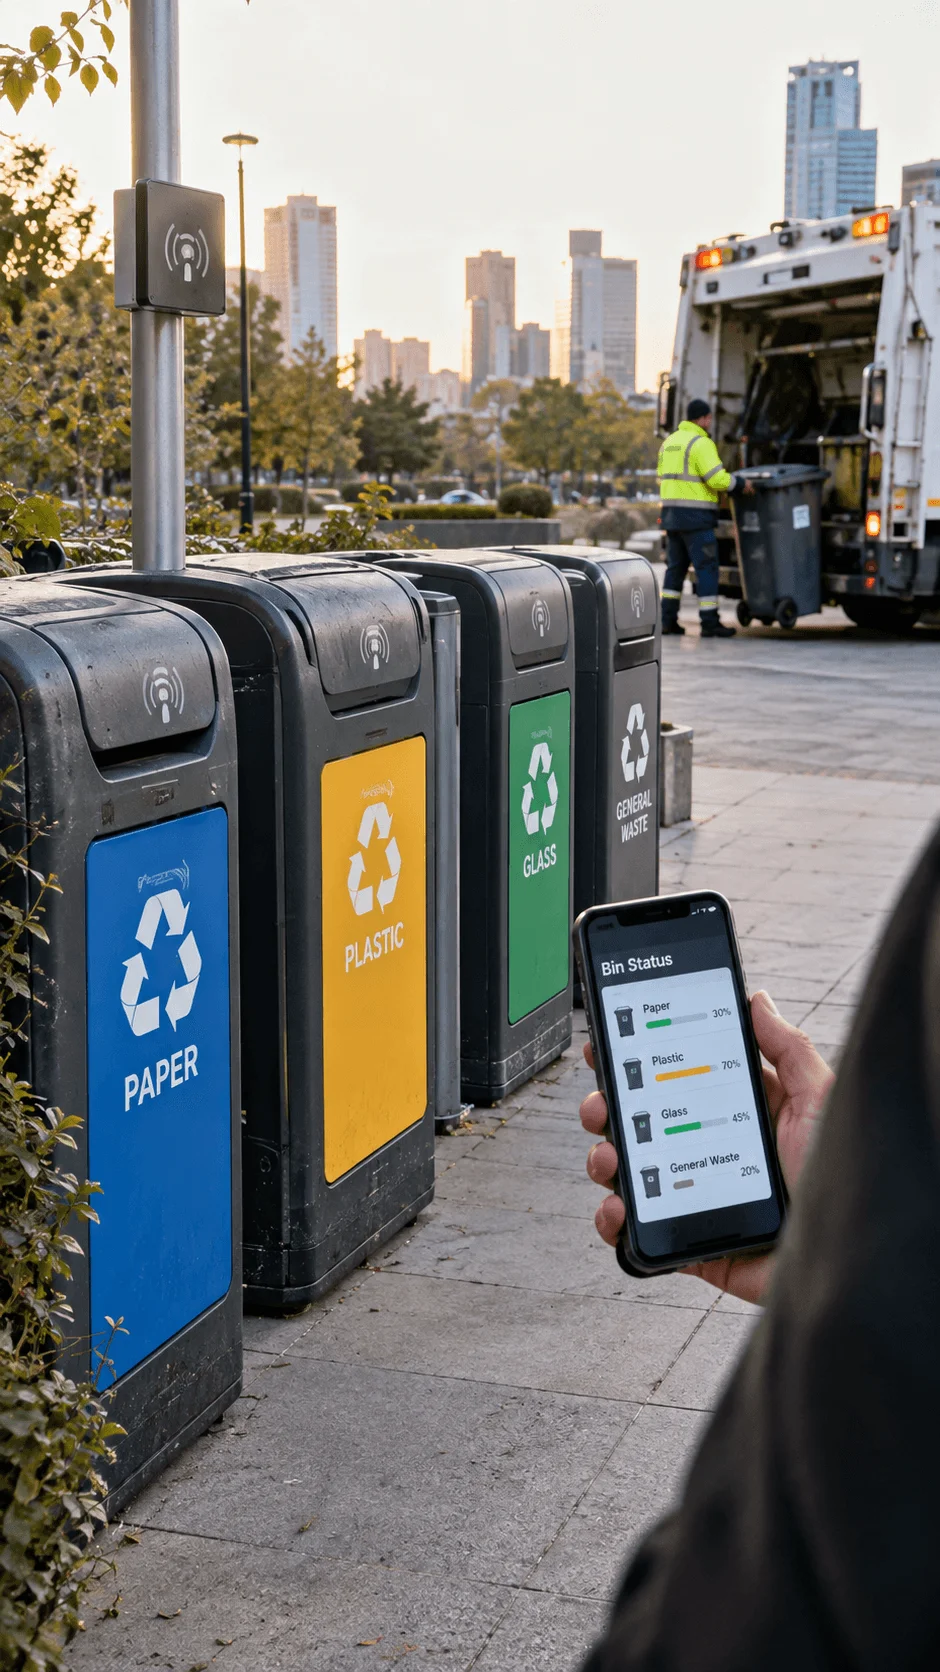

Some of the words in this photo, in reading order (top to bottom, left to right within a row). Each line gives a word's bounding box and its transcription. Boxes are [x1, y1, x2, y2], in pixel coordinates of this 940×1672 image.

[617, 789, 652, 820] GENERAL
[621, 814, 648, 843] WASTE
[523, 844, 557, 878] GLASS
[344, 922, 404, 973] PLASTIC
[601, 959, 625, 976] Bin
[627, 953, 673, 972] Status
[643, 1000, 670, 1015] Paper
[712, 1007, 732, 1019] 30%
[652, 1051, 684, 1067] Plastic
[721, 1059, 741, 1071] 70%
[124, 1044, 199, 1112] PAPER
[661, 1106, 688, 1119] Glass
[670, 1157, 708, 1175] General
[709, 1151, 740, 1168] Waste
[740, 1165, 760, 1177] 20%
